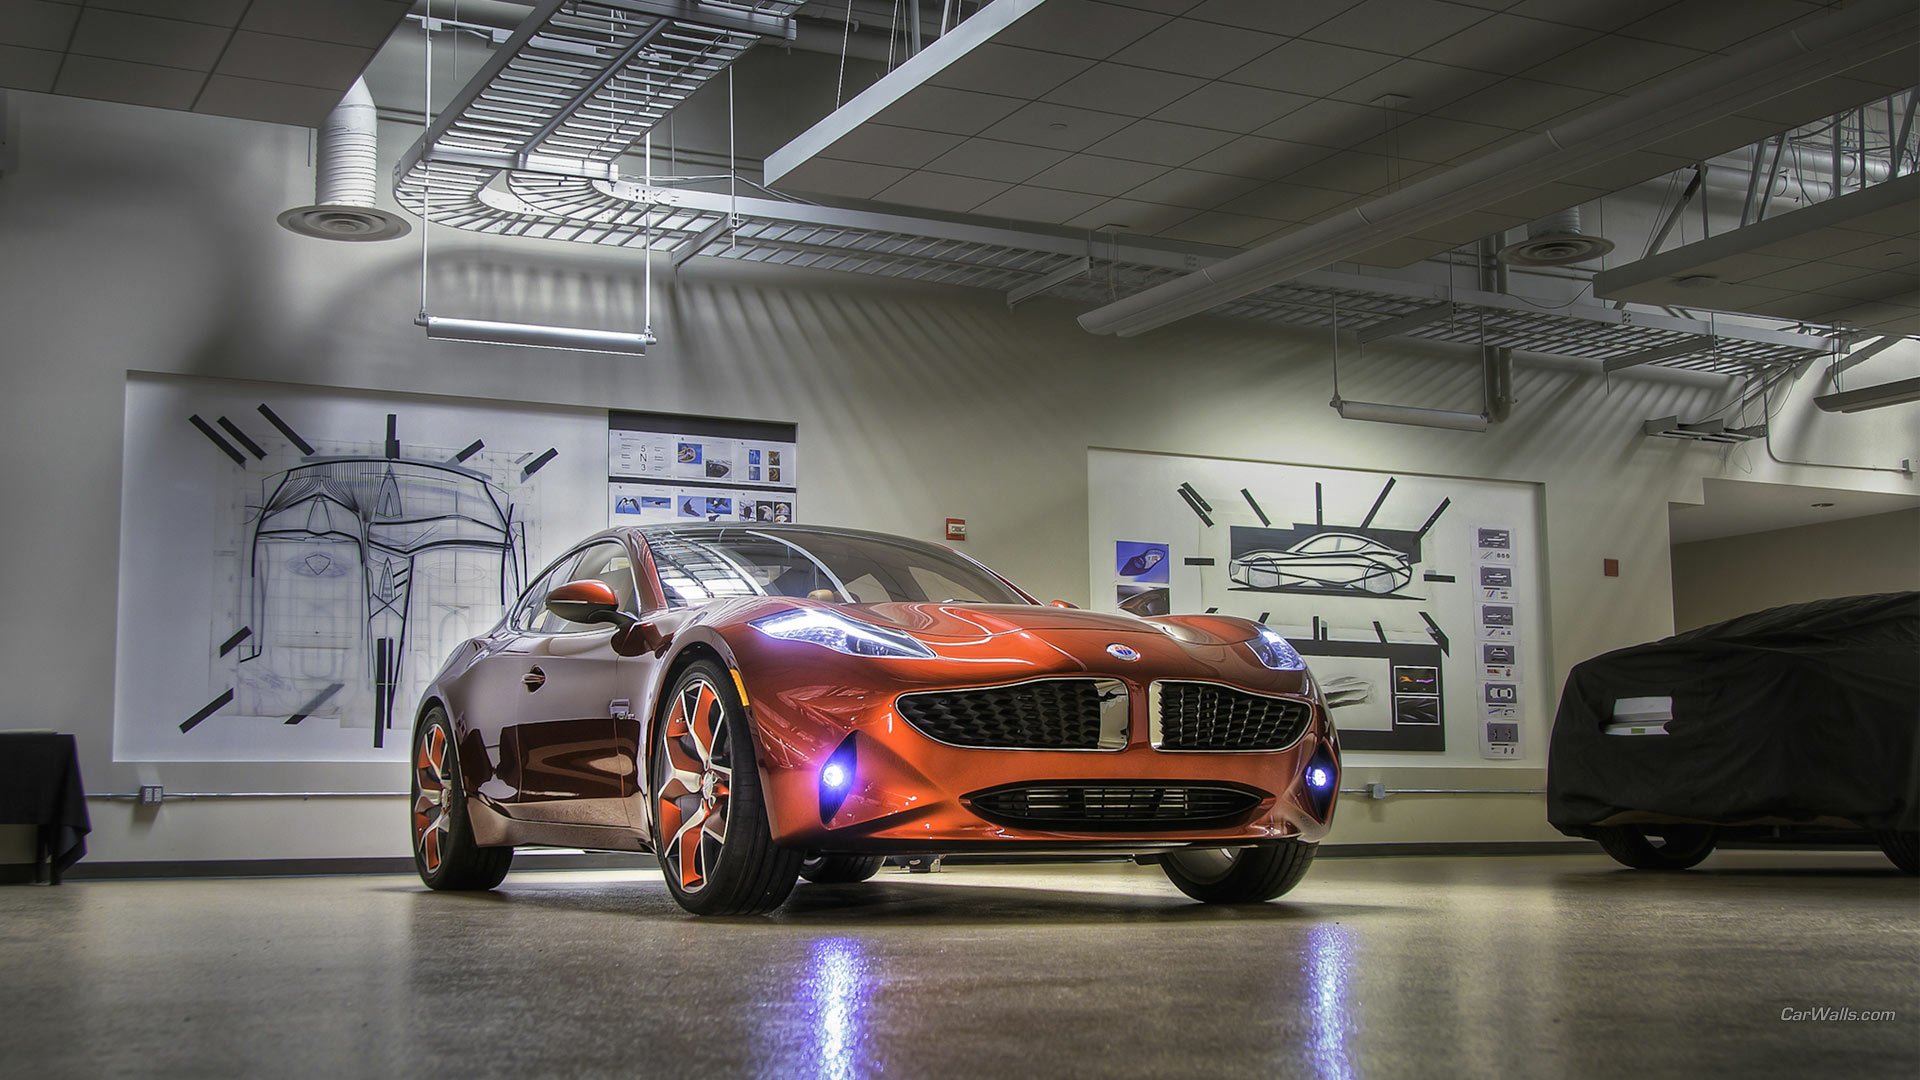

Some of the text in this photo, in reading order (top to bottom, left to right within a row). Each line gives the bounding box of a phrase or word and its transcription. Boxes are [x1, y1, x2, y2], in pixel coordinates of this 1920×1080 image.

[640, 444, 647, 453] 5
[640, 453, 647, 462] N
[640, 463, 647, 471] 3
